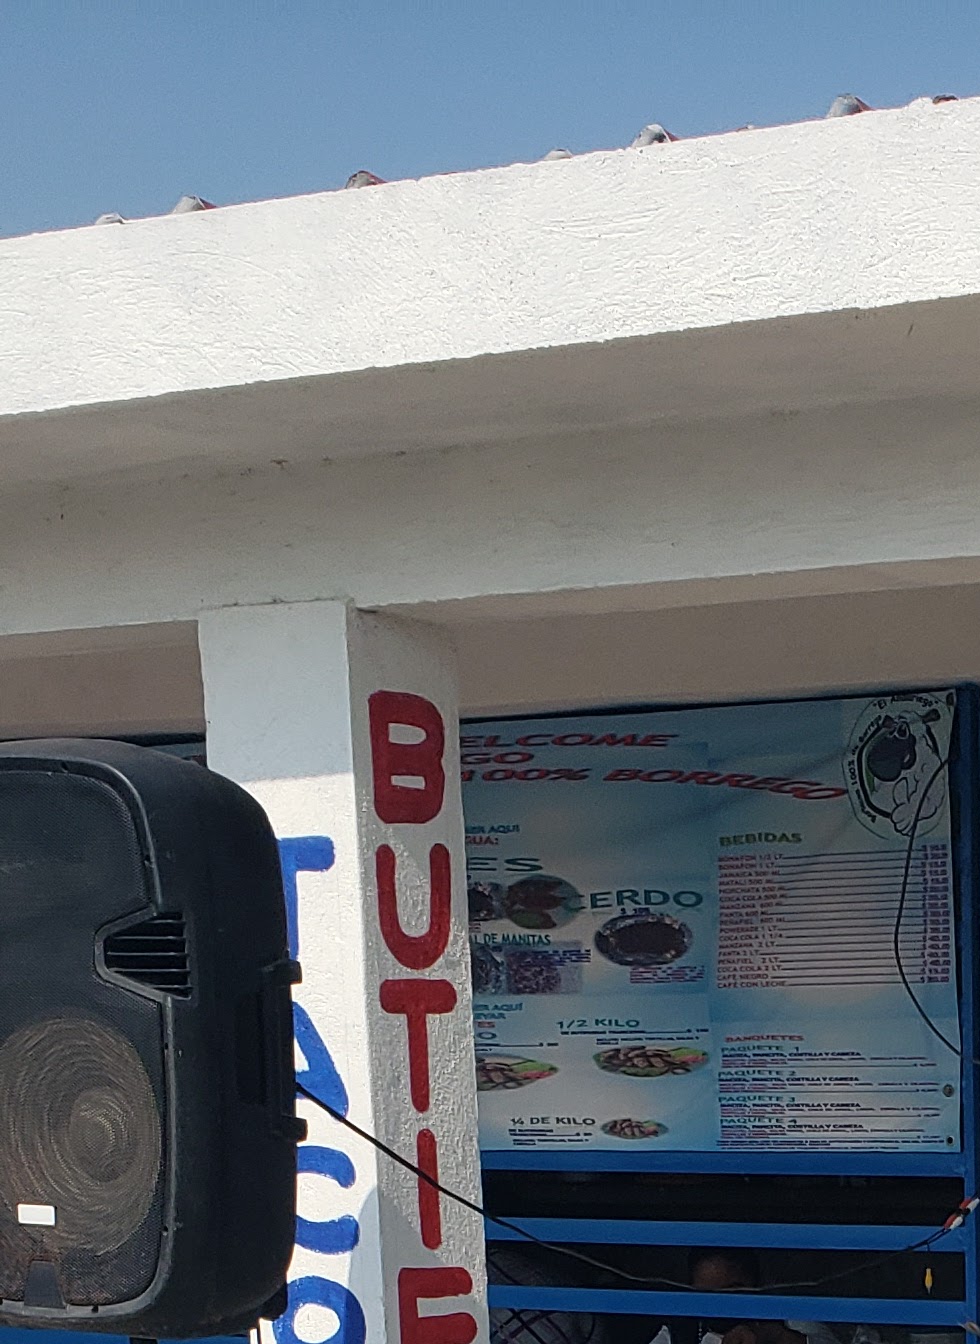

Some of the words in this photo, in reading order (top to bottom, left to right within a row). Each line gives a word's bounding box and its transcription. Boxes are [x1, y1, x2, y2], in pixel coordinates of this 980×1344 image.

[460, 733, 680, 748] ELCOME
[461, 752, 534, 765] GO
[604, 769, 850, 800] BORREGO
[465, 836, 499, 845] GUA:
[719, 831, 803, 847] BEBIDAS
[468, 857, 543, 872] ES
[483, 933, 498, 944] DE
[501, 933, 551, 947] MANITAS
[557, 1019, 588, 1030] 1/2
[594, 1018, 640, 1028] KILO
[725, 1034, 804, 1043] BANQUETES
[721, 1044, 784, 1052] PAQUETE
[718, 1070, 784, 1078] PAQUETE
[530, 1116, 550, 1126] DE
[555, 1117, 596, 1126] KILO
